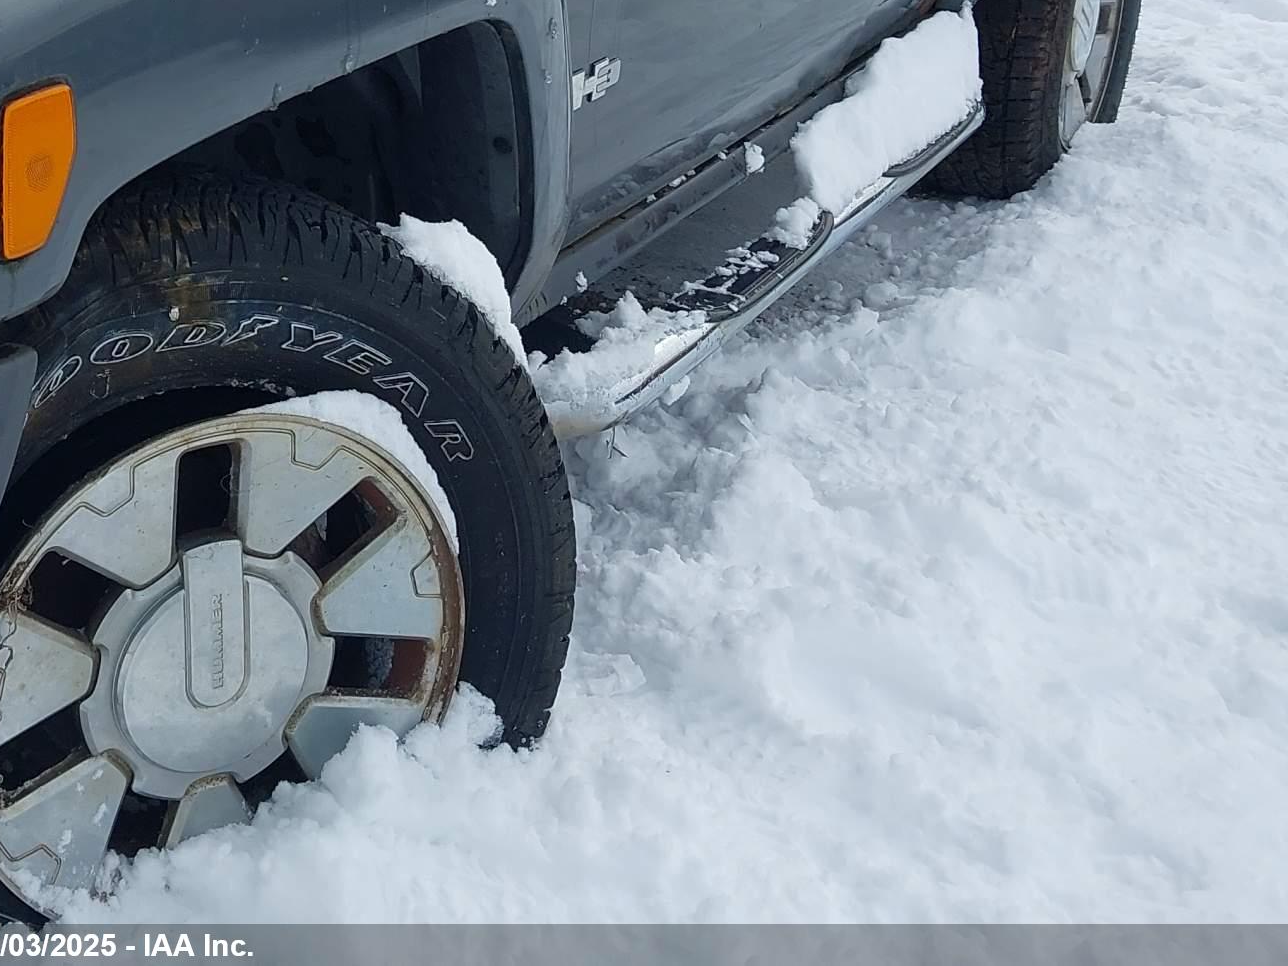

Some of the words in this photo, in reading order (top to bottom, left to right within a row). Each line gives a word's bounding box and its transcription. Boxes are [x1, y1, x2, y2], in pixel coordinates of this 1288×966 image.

[572, 56, 621, 112] H3
[33, 315, 475, 463] OODYEAR
[212, 592, 225, 690] HUMMER
